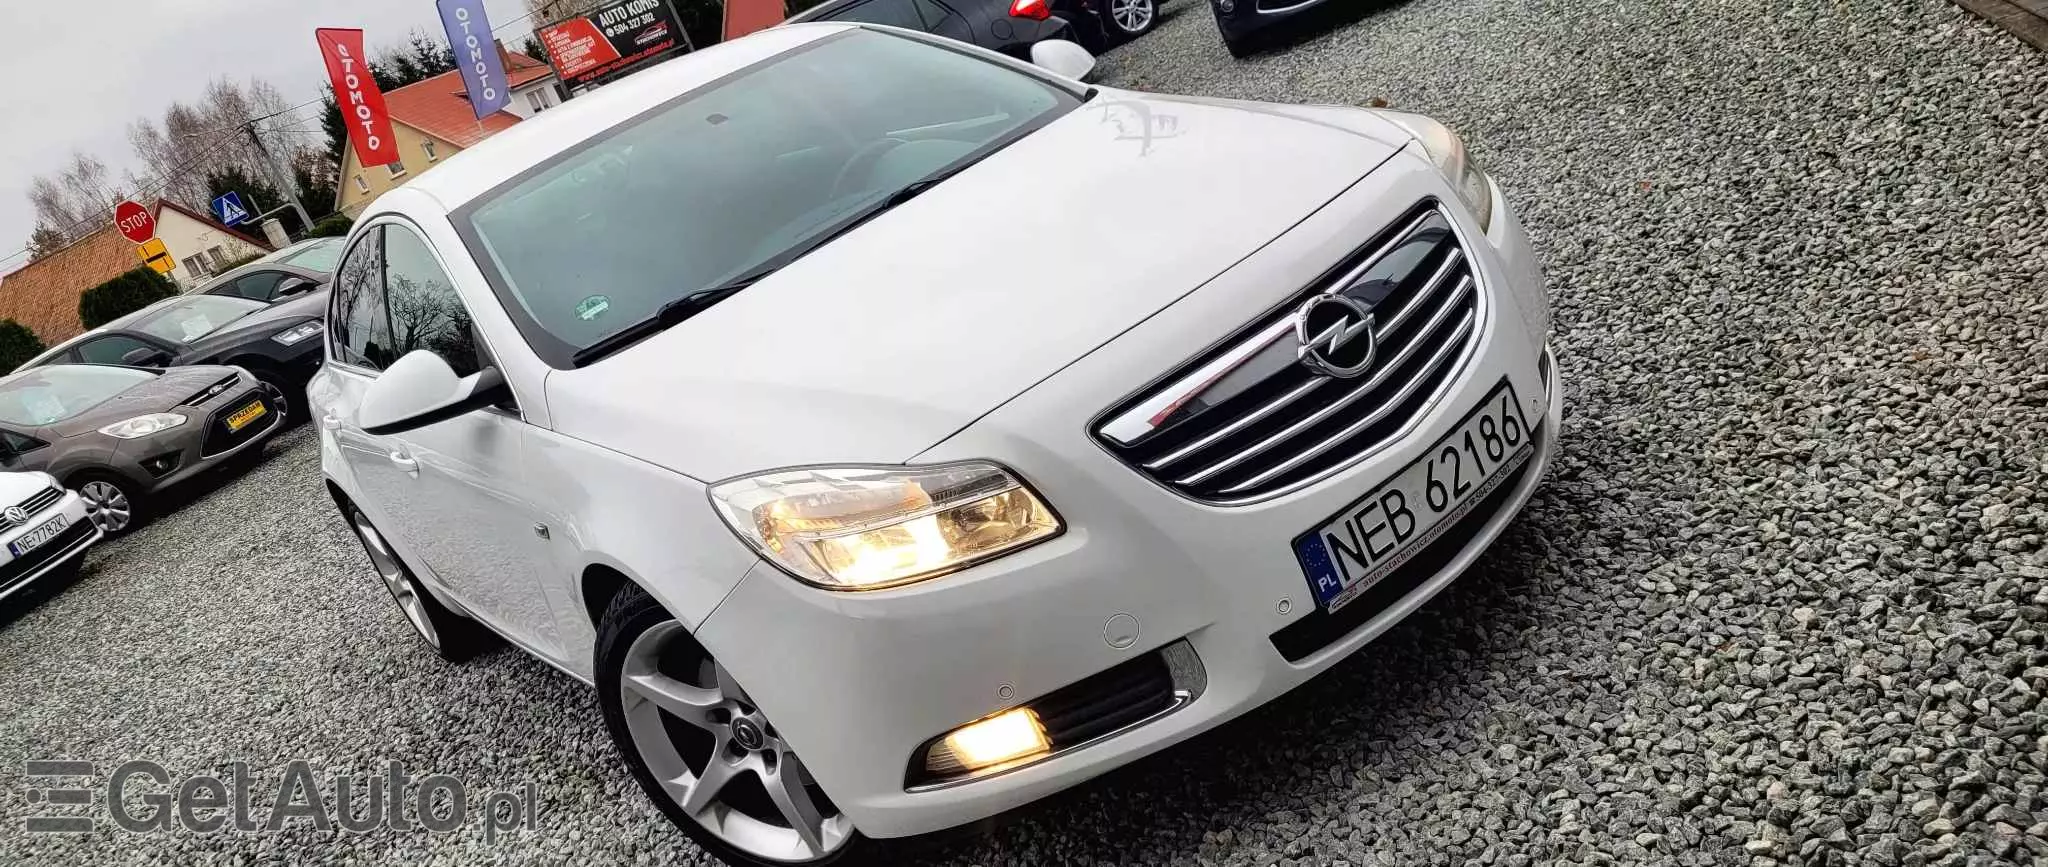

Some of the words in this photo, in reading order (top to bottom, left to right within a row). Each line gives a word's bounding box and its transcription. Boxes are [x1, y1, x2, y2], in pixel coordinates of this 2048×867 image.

[599, 6, 628, 27] AUTO
[626, 0, 660, 17] KOMIS
[613, 22, 629, 35] 504
[627, 17, 641, 29] 327
[640, 12, 656, 25] 302
[456, 8, 496, 101] OTOMOTO
[337, 44, 380, 150] OTOMOTO
[121, 211, 147, 233] STOP
[1326, 489, 1416, 582] NEB
[1425, 396, 1521, 513] 62186
[17, 536, 36, 553] NE
[33, 517, 67, 541] 7782K
[1317, 572, 1337, 593] PL
